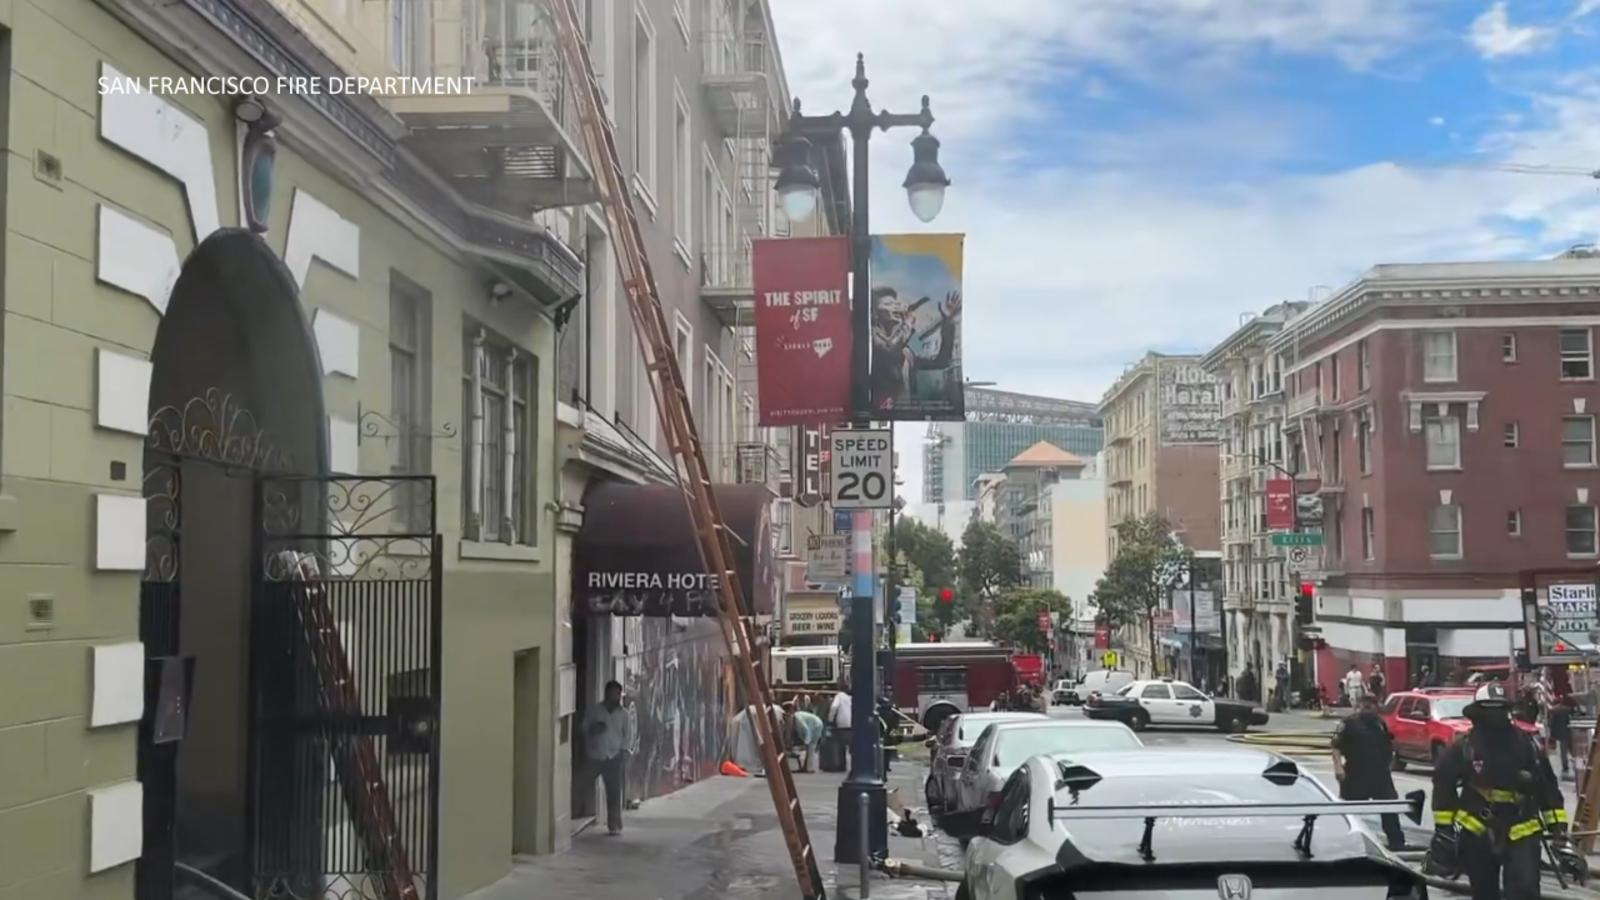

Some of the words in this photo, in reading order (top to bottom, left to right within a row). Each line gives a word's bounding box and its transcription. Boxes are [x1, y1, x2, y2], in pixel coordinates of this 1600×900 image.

[764, 291, 791, 307] THE
[794, 289, 842, 305] SPIRIT
[789, 309, 801, 331] of
[802, 307, 819, 322] SF
[835, 439, 888, 452] SPEED
[840, 455, 882, 468] LIMIT
[837, 471, 886, 501] 20
[588, 572, 663, 589] RIVIERA
[667, 573, 721, 590] HOTE
[814, 611, 839, 621] LIQUORS
[792, 622, 811, 631] BEER
[816, 622, 835, 631] WINE
